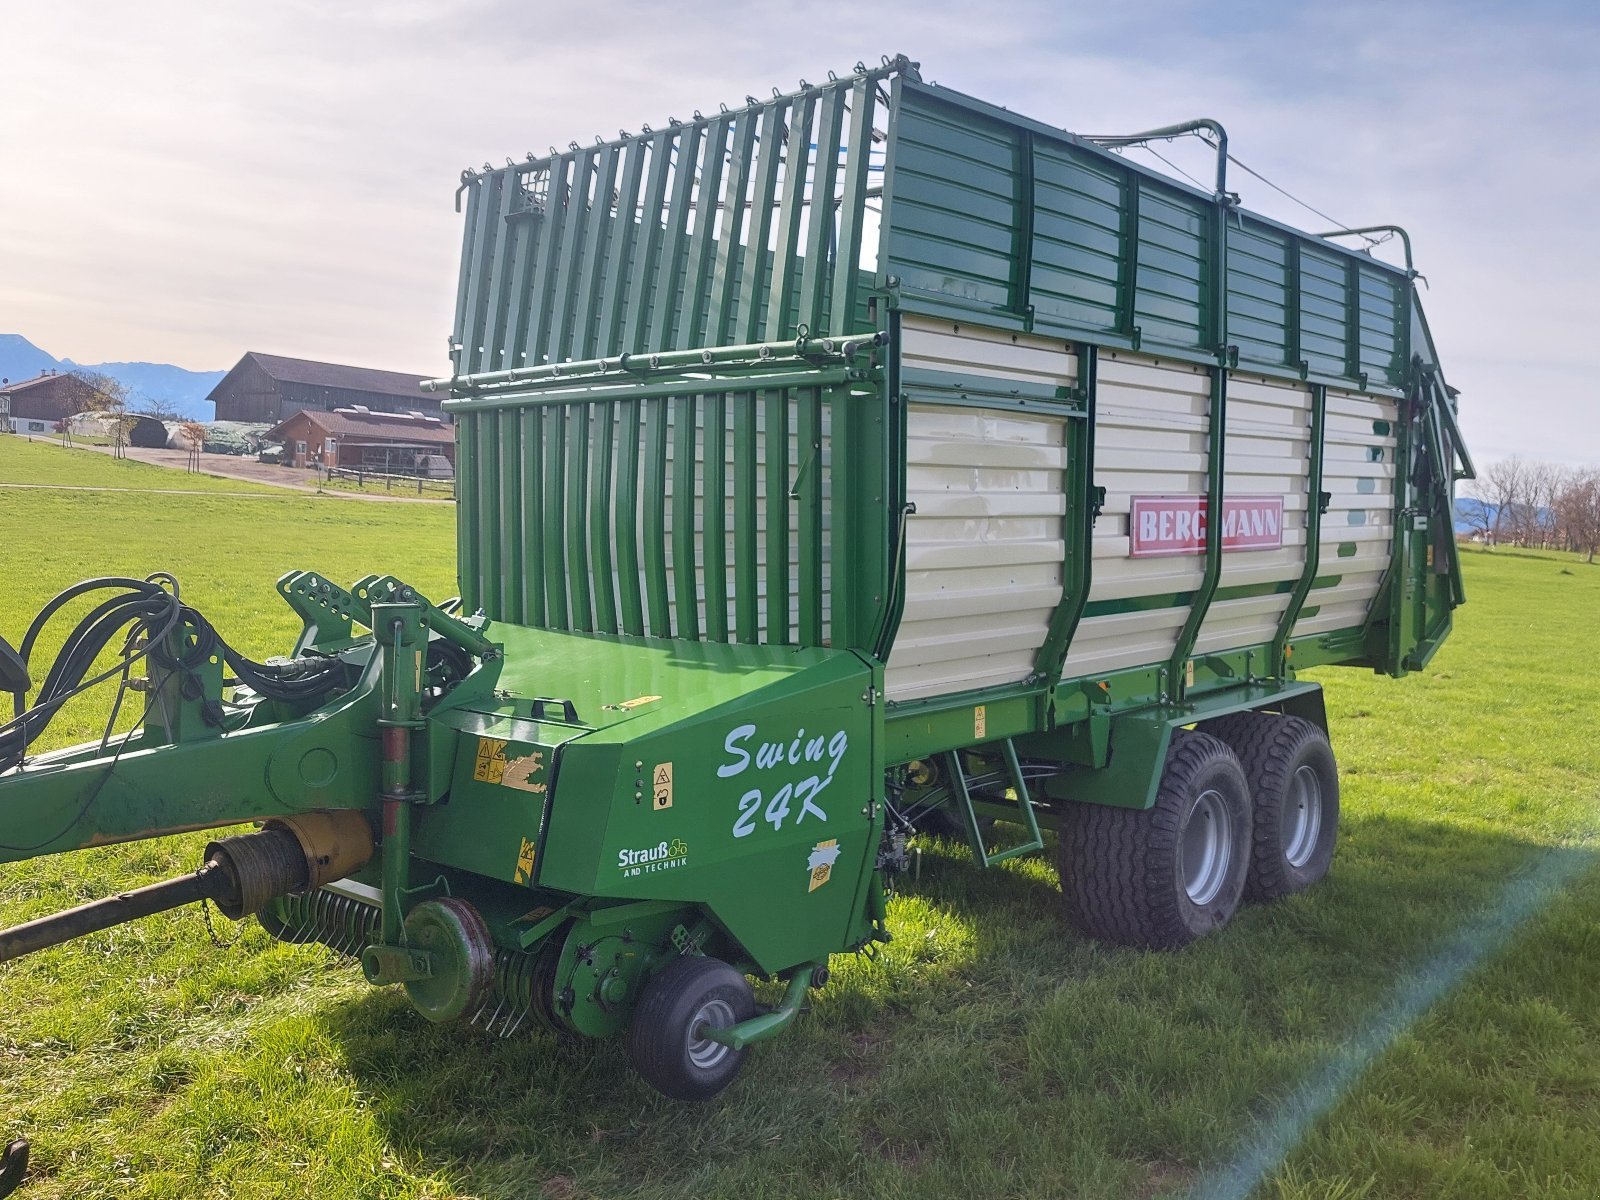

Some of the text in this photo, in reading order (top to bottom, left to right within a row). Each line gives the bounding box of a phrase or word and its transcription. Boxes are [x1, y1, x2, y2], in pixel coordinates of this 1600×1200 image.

[717, 724, 848, 777] Swing
[732, 775, 833, 838] 24K
[618, 841, 668, 867] Strauß
